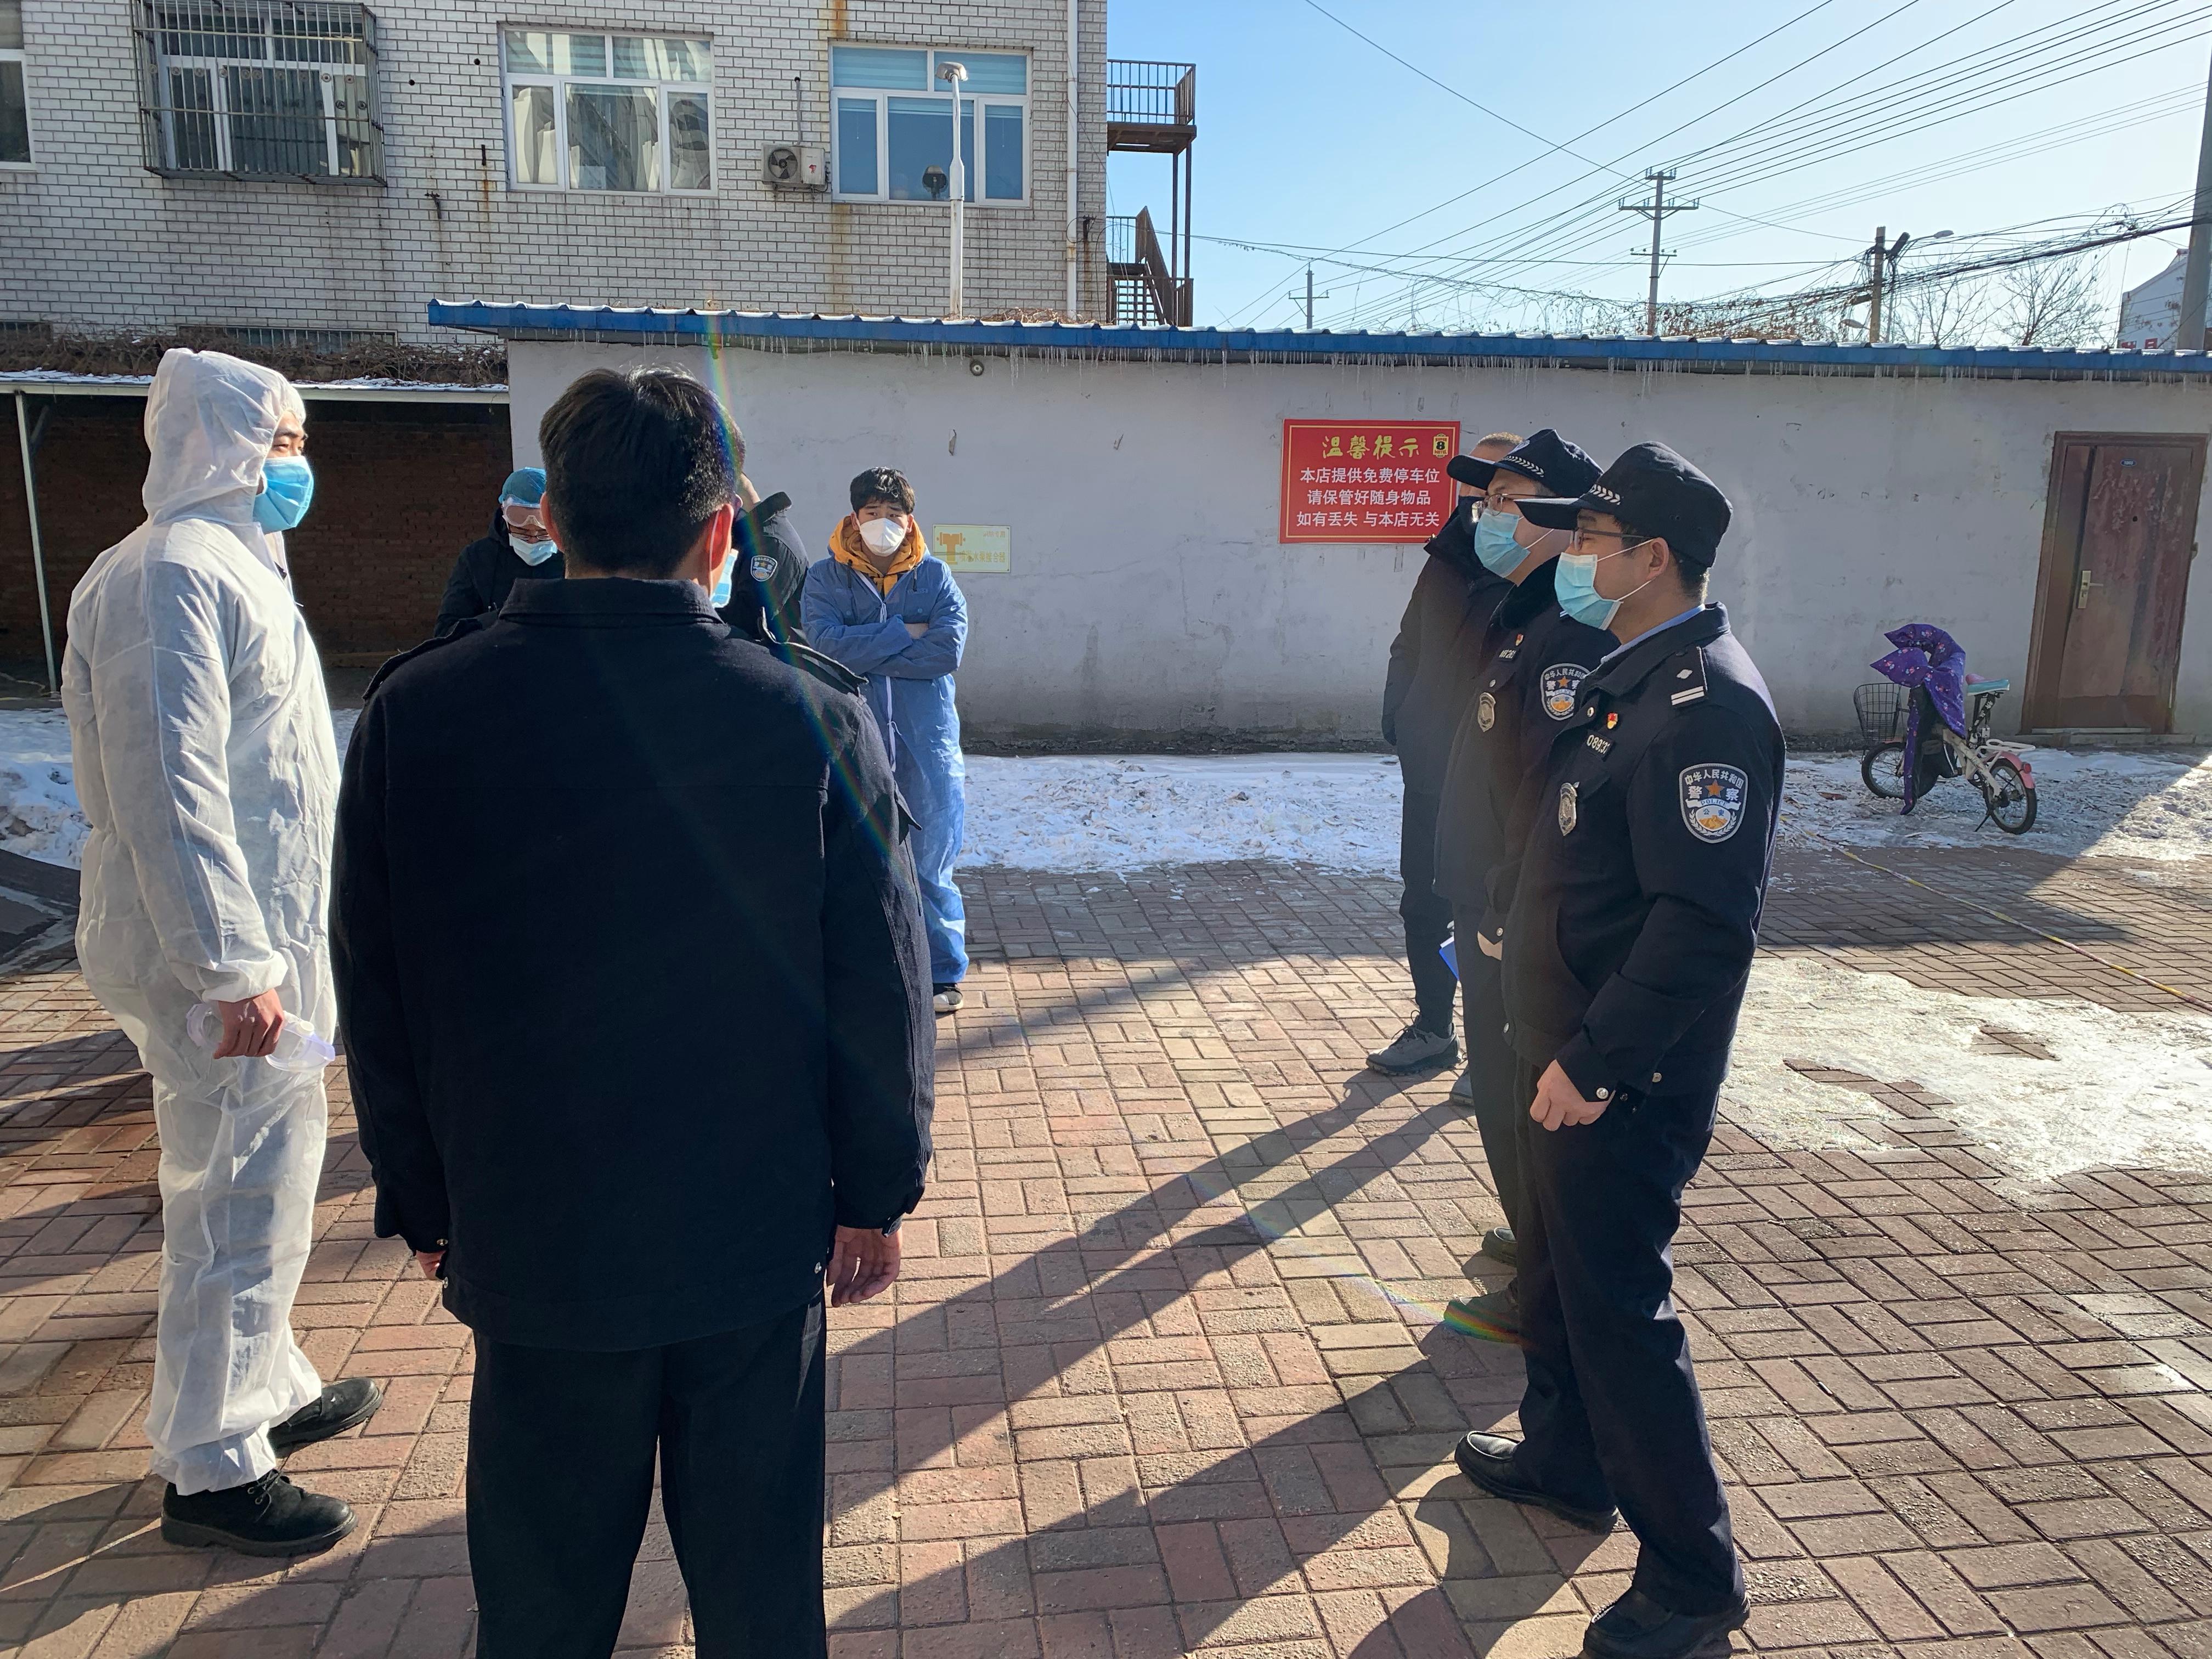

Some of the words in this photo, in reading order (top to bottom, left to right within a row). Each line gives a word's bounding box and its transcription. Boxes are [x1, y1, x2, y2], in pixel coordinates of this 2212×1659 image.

[1322, 435, 1419, 460] 温馨提示
[1436, 441, 1445, 450] 8
[1300, 467, 1440, 483] 本店提供免费停车位
[1307, 489, 1431, 505] 请保管好随身物品
[1296, 511, 1358, 527] 如有丢失
[1363, 511, 1440, 527] 与本店无关
[1684, 769, 1744, 789] 中华人民共和国
[1701, 798, 1728, 807] POLICE
